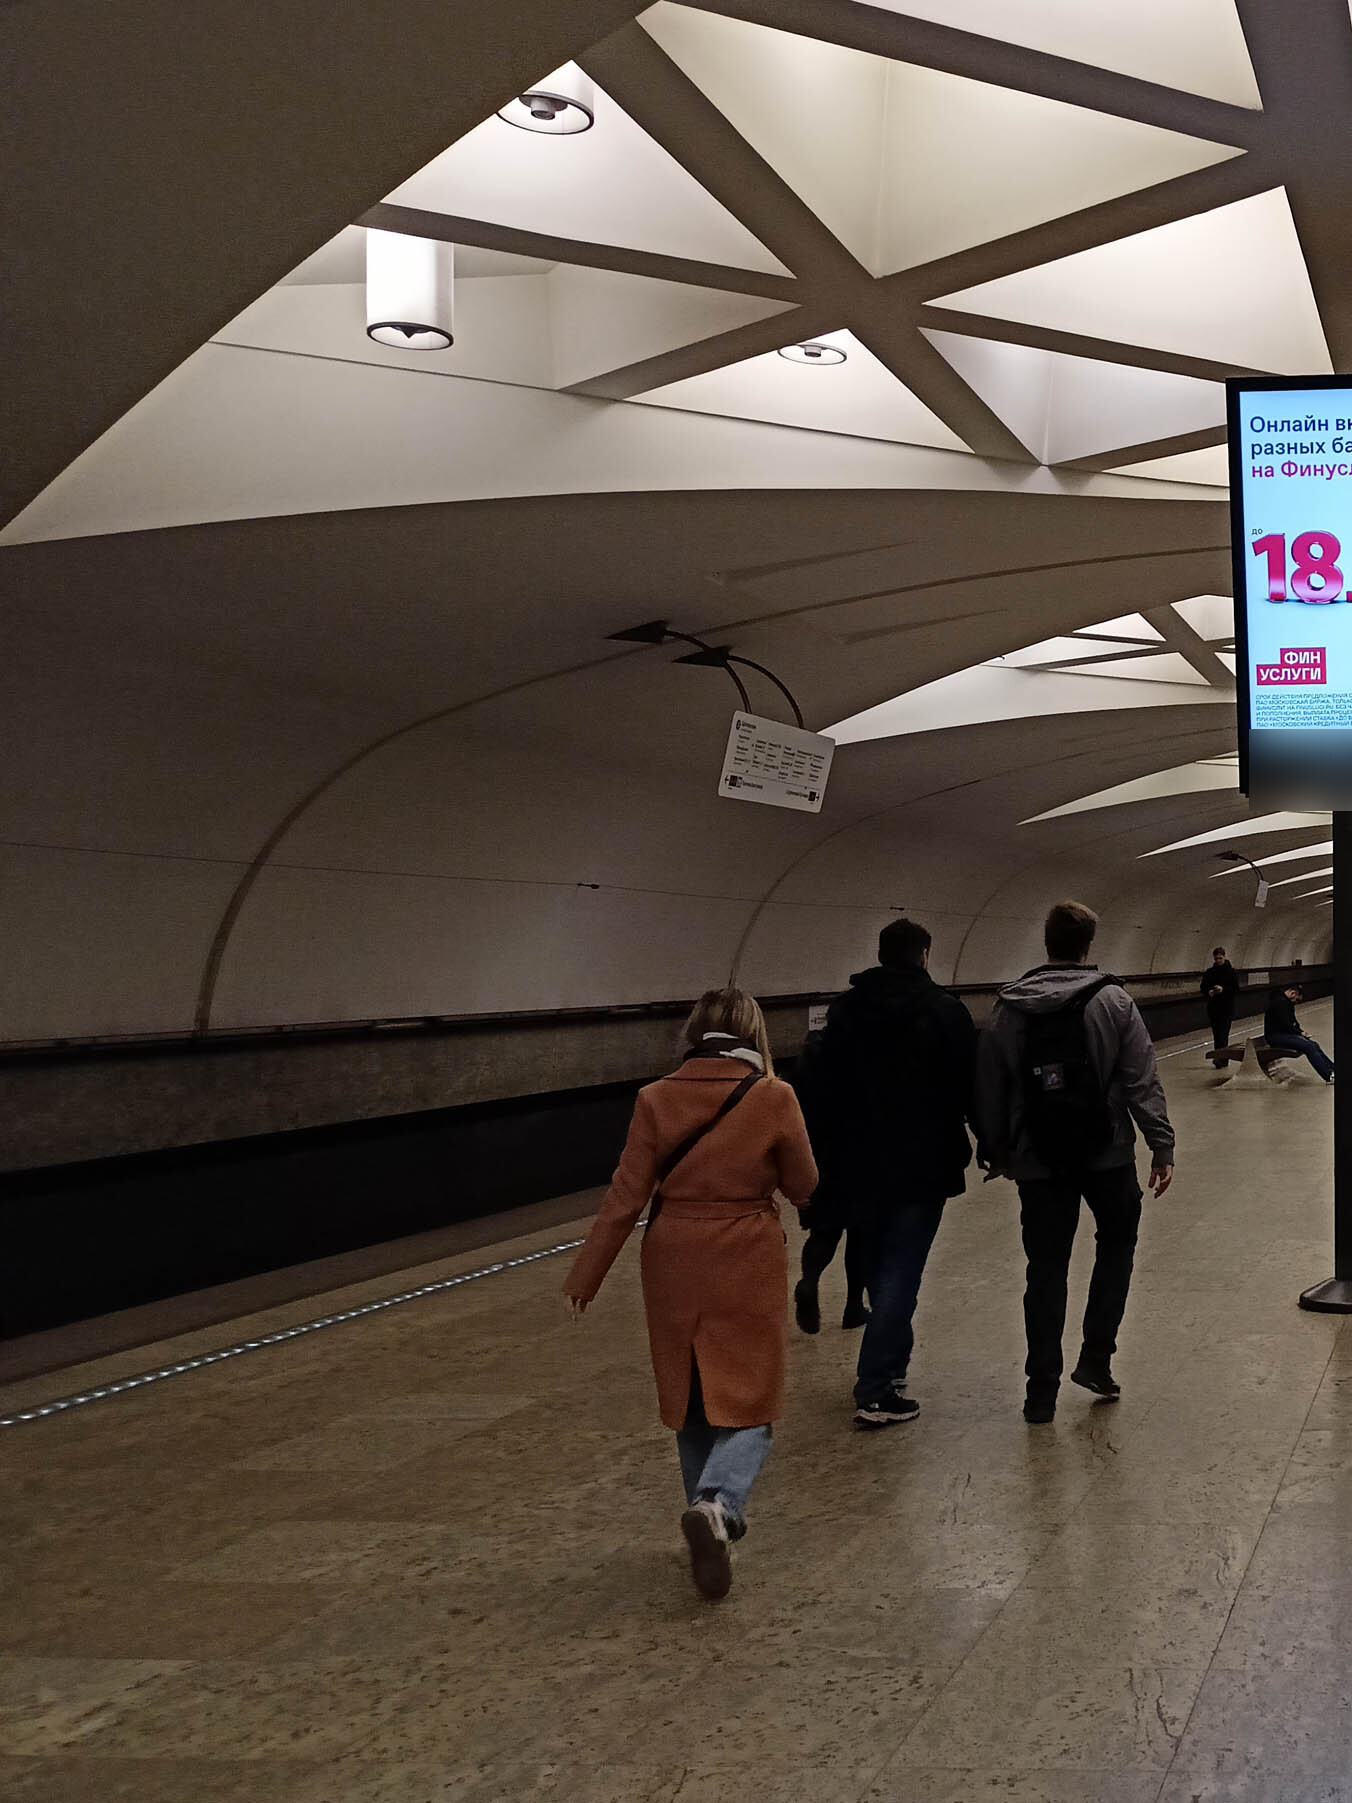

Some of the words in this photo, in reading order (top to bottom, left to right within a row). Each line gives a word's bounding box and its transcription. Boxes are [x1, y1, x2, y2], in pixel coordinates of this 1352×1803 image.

[1250, 415, 1329, 432] Онлайн
[1251, 442, 1326, 460] разных
[1252, 465, 1275, 478] на
[1284, 651, 1321, 665] ФИН
[1260, 667, 1321, 681] УСЛУГИ
